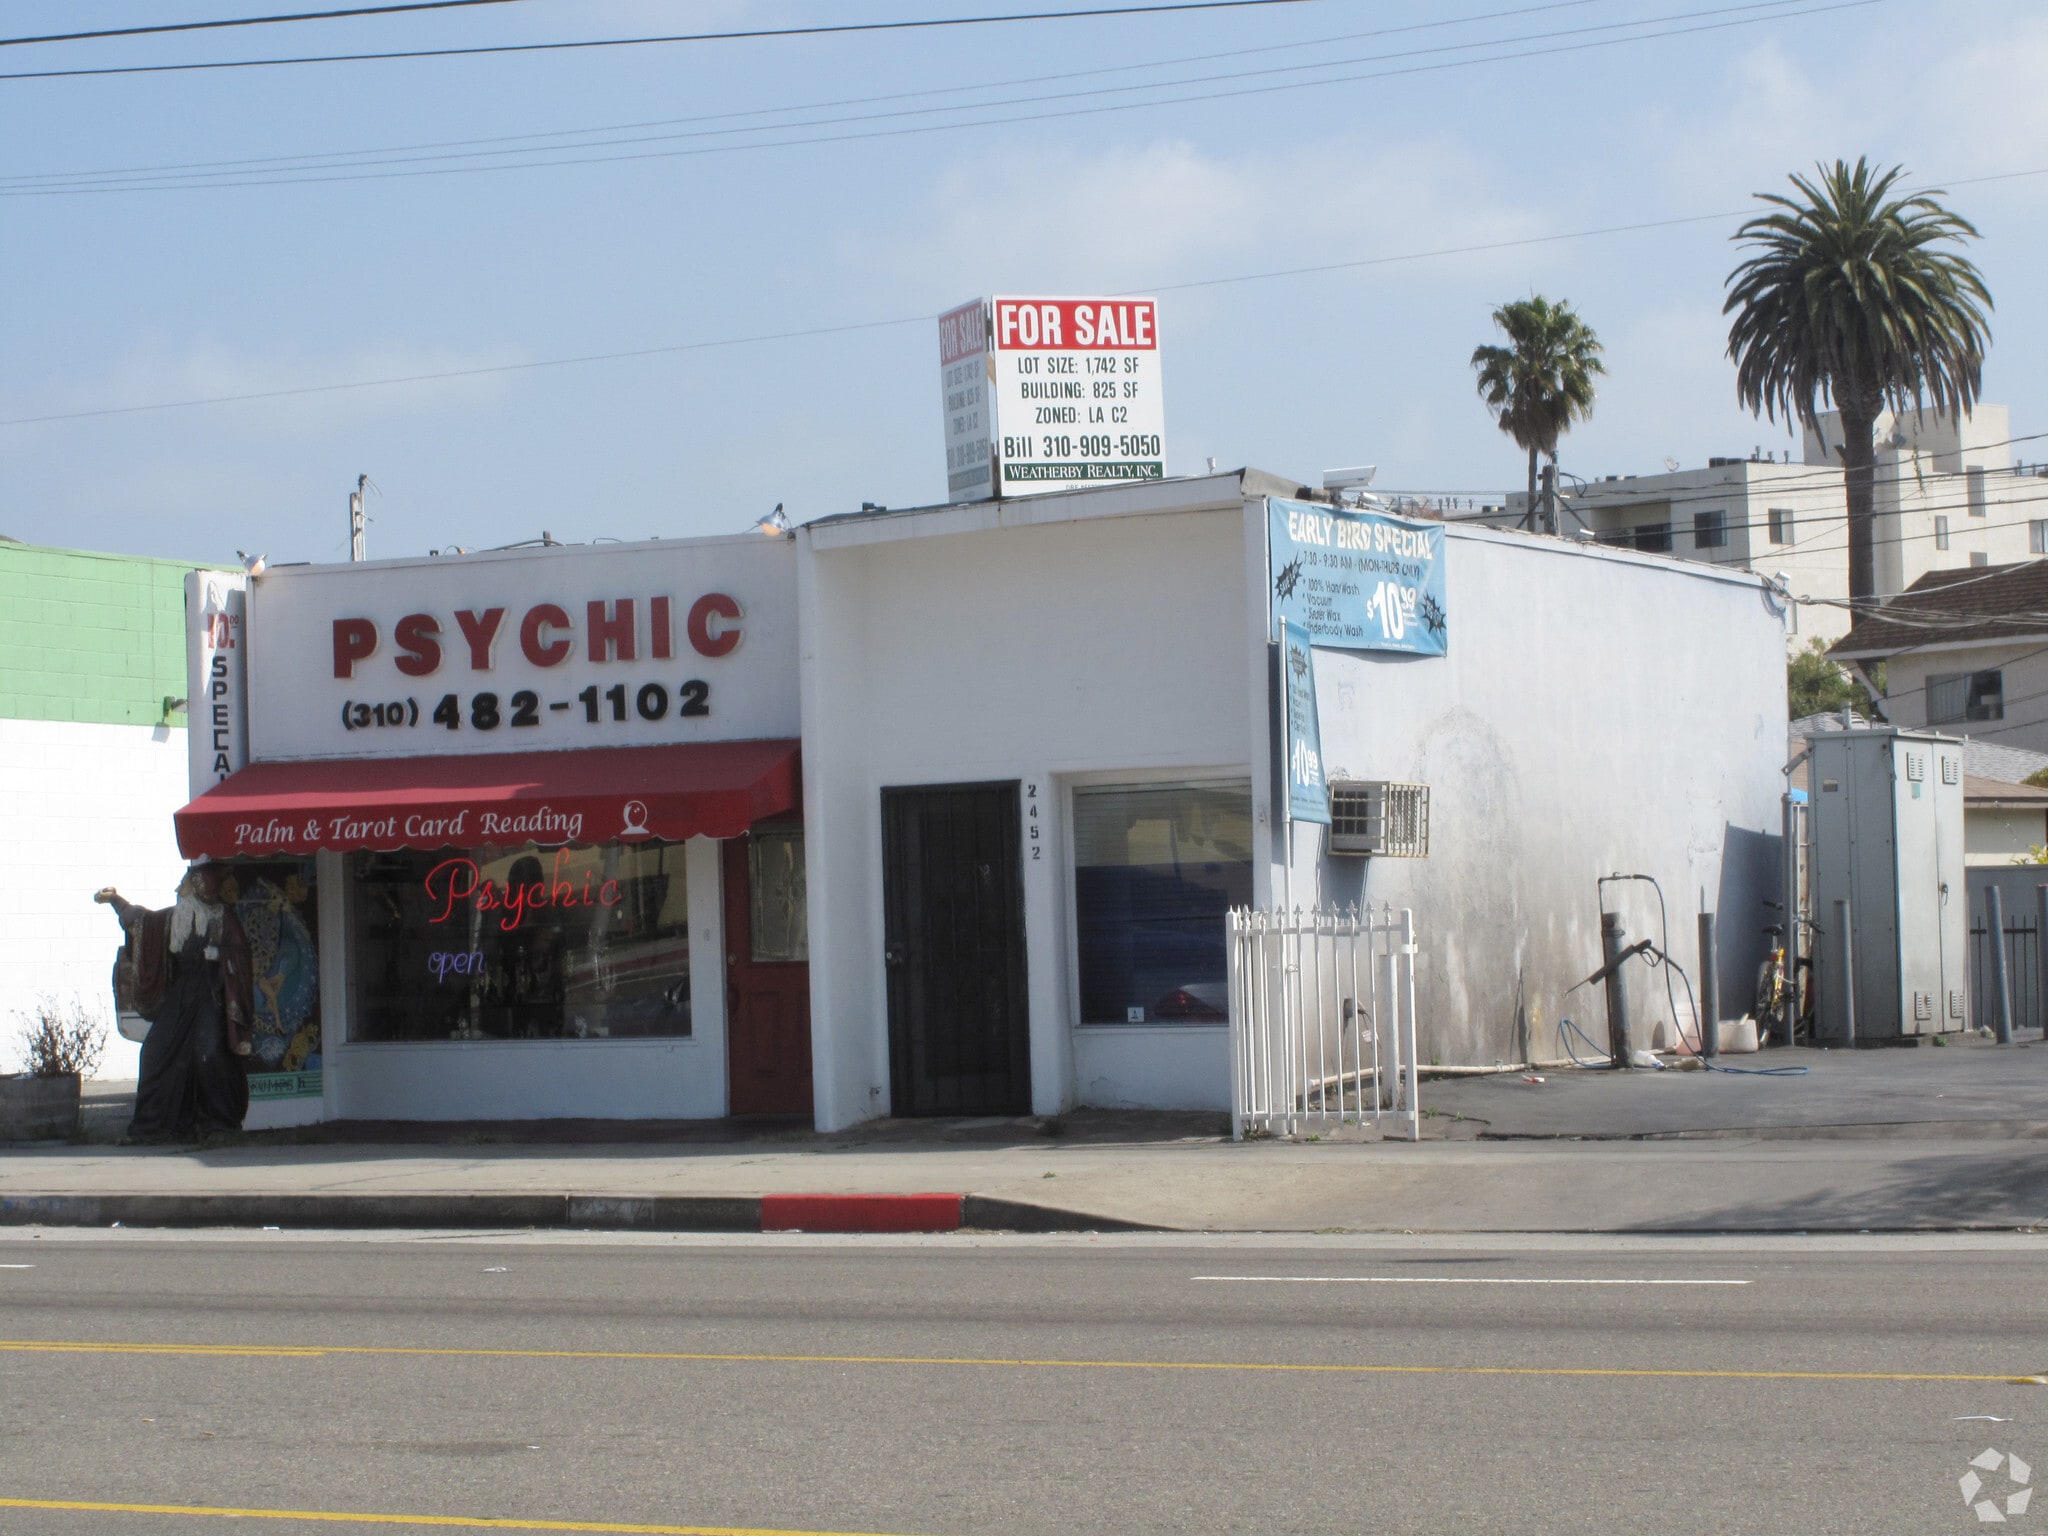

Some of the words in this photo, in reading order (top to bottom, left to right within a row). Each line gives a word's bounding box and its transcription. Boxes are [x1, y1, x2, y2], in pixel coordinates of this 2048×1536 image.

[1001, 304, 1062, 345] FOR
[1074, 305, 1152, 345] SALE
[1018, 357, 1040, 374] LOT
[1048, 357, 1078, 374] SIZE:
[1086, 357, 1116, 376] 1,742
[1124, 357, 1139, 374] SF
[1021, 382, 1085, 399] BUILDING:
[1093, 382, 1117, 399] 825
[1124, 382, 1139, 399] SF
[1035, 407, 1081, 424] ZONED:
[1088, 406, 1105, 423] LA
[1111, 406, 1128, 423] C2
[1004, 436, 1033, 458] Bill
[1043, 435, 1161, 457] 310-909-5050
[1009, 465, 1084, 479] WEATHERBY
[1288, 511, 1334, 546] EARLY
[1337, 519, 1371, 550] BIRD
[1374, 523, 1433, 560] SPECIAL
[333, 593, 745, 678] PSYCHIC
[1344, 624, 1363, 637] Wash
[342, 696, 419, 731] (310)
[433, 680, 712, 730] 482-1102
[235, 818, 295, 844] Palm
[303, 819, 321, 841] &
[329, 815, 397, 840] Tarot
[404, 809, 469, 837] Card
[480, 806, 584, 838] Reading
[1027, 784, 1041, 860] 2452
[425, 847, 622, 931] Psychic
[428, 951, 485, 984] open
